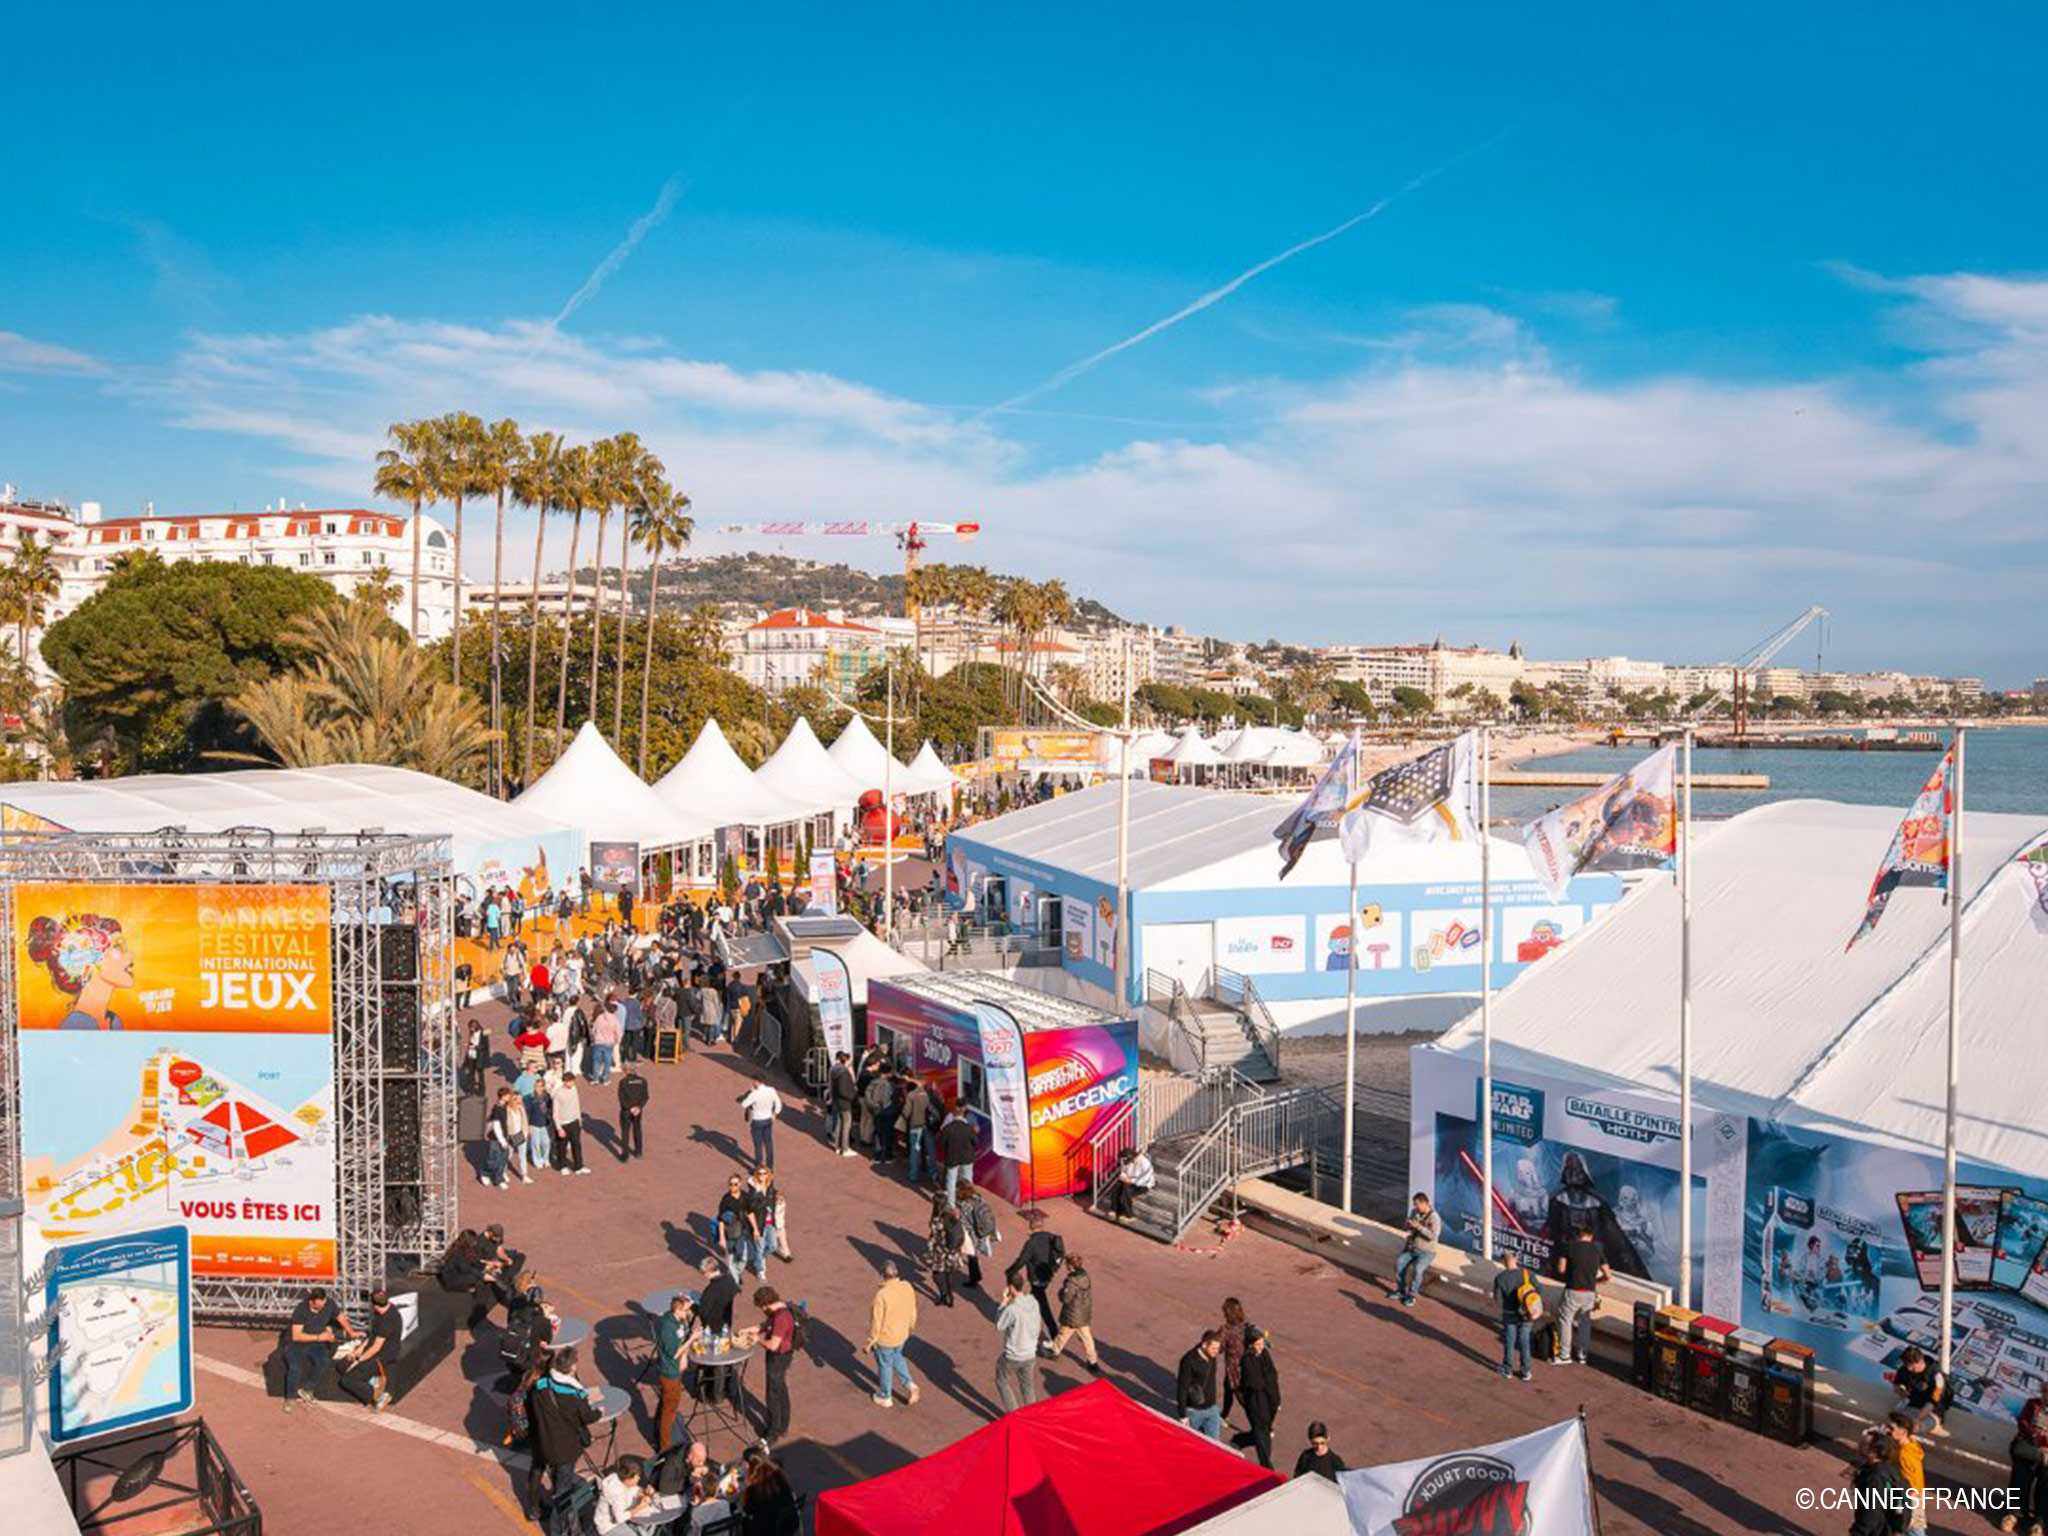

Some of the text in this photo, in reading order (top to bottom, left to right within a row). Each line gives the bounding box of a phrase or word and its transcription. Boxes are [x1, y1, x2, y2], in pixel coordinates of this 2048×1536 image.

[199, 907, 316, 932] CANNES
[200, 934, 316, 955] FESTIVAL
[200, 958, 316, 970] INTERNATIONAL
[200, 973, 317, 1009] JEUX
[923, 1037, 952, 1066] SHOP
[258, 1072, 280, 1080] PORT
[1031, 1076, 1130, 1128] GAMEGENIC
[1492, 1091, 1533, 1114] STAR
[1570, 1100, 1632, 1124] BATAILLE
[1493, 1119, 1534, 1140] LIMITED
[1607, 1124, 1648, 1140] HOTH
[180, 1197, 321, 1221] VOUS ÊTES ICI
[1464, 1222, 1550, 1258] POSIBILITÉS
